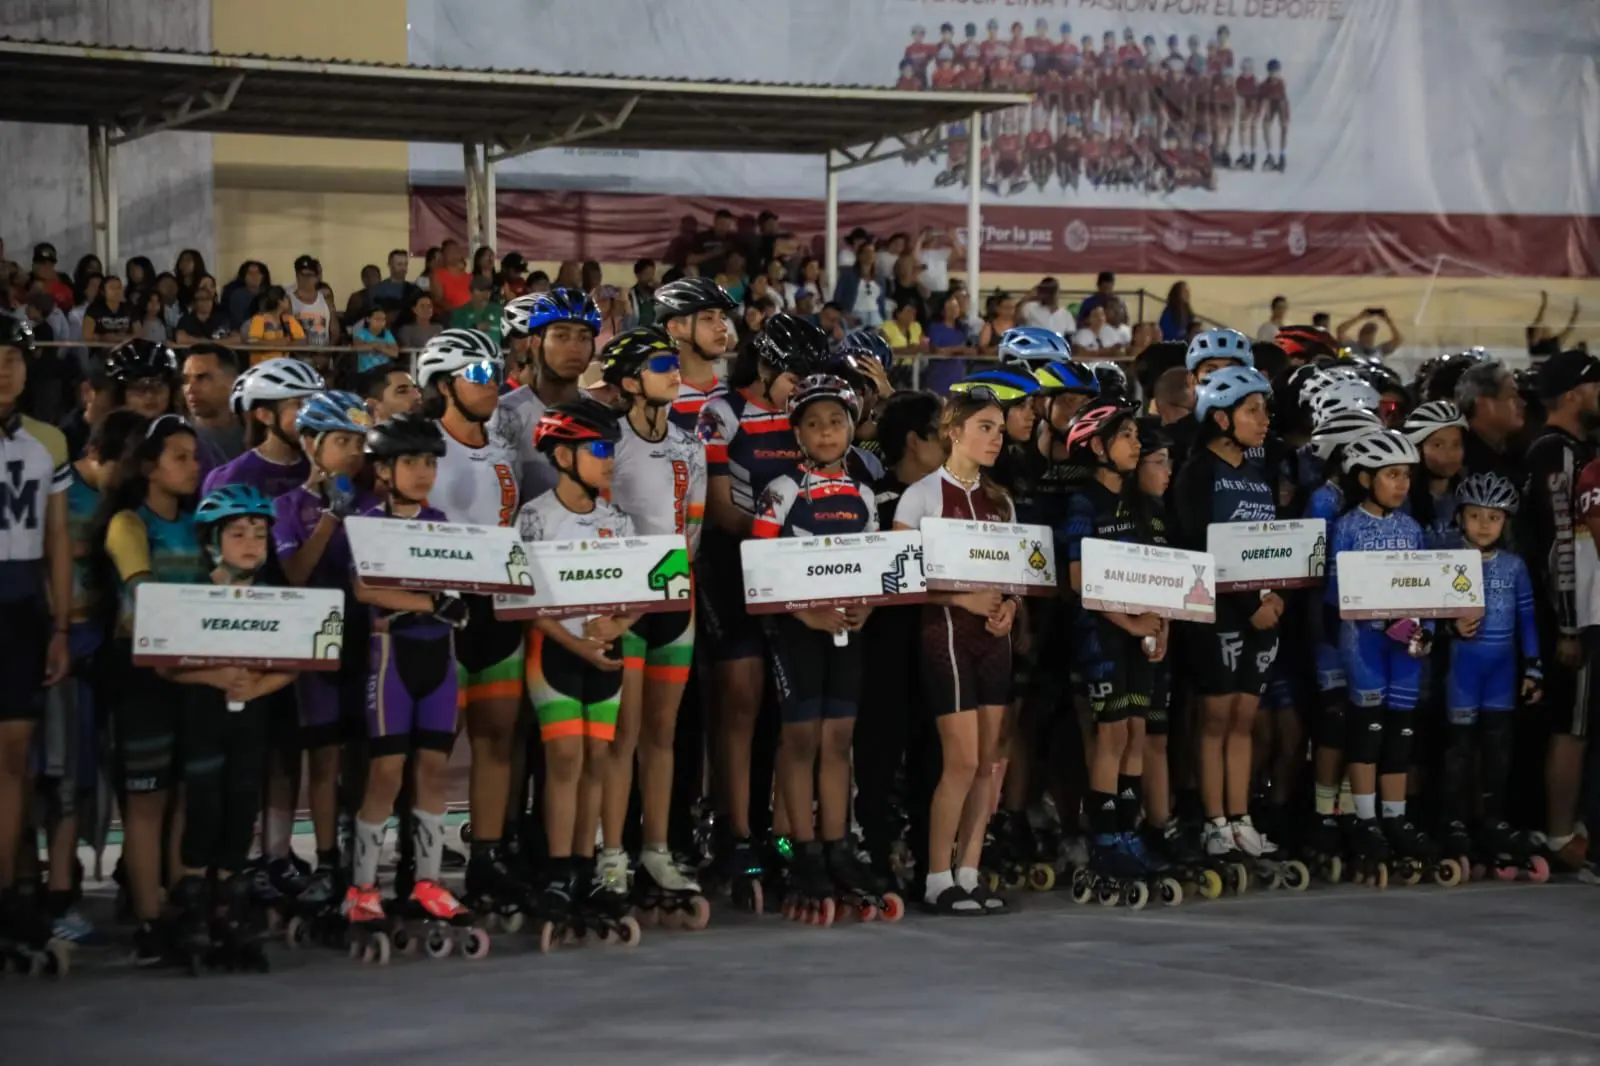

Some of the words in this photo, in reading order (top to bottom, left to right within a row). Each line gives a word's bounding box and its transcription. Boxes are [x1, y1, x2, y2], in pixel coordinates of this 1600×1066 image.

[1214, 0, 1236, 17] EL
[986, 227, 1010, 241] Por
[1013, 226, 1026, 241] la
[1029, 229, 1053, 245] paz
[409, 547, 473, 561] TLAXCALA
[969, 549, 1010, 561] SINALOA
[1241, 546, 1292, 561] QUERÉTARO
[559, 568, 623, 581] TABASCO
[807, 563, 862, 576] SONORA
[1104, 569, 1124, 581] SAN
[1126, 573, 1147, 584] LUIS
[1149, 575, 1184, 588] POTOSÍ
[1391, 577, 1431, 588] PUEBLA
[201, 618, 280, 632] VERACRUZ
